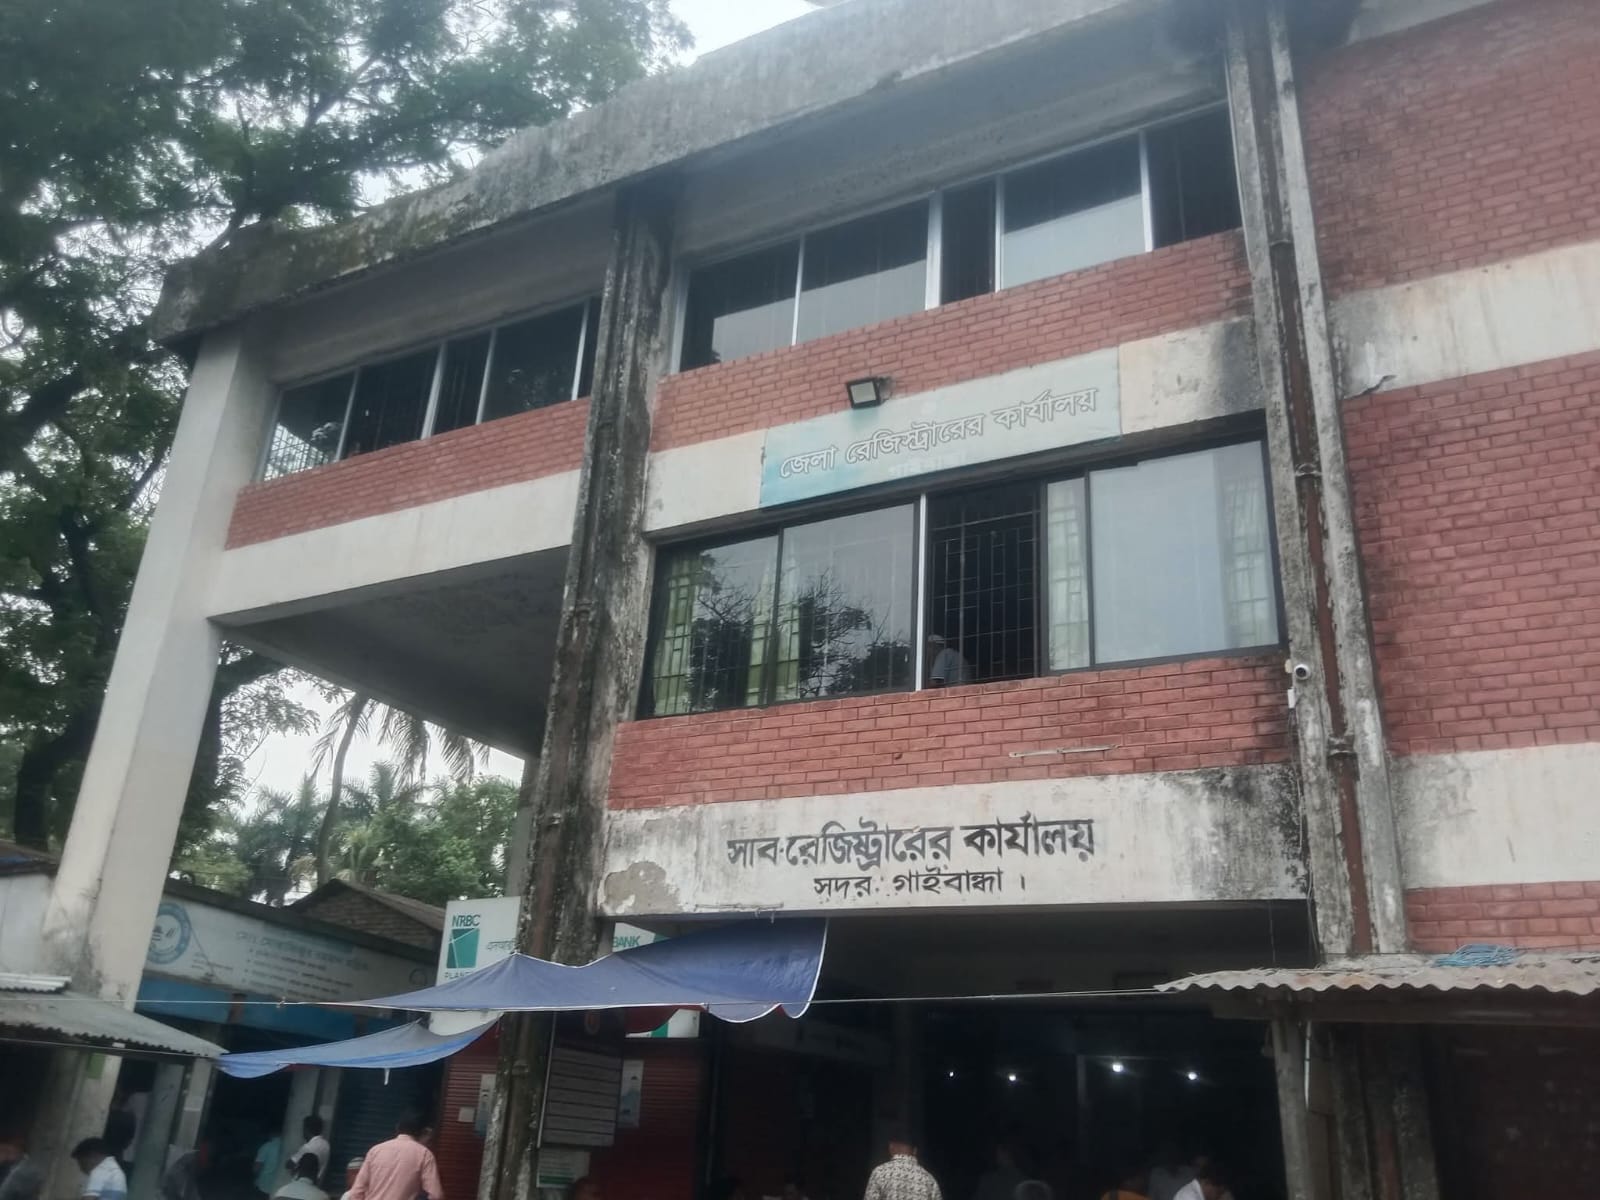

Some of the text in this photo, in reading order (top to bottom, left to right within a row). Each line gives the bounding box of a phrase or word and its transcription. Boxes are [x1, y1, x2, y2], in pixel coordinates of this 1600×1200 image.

[780, 444, 839, 478] জেলা
[845, 413, 985, 465] রেজিস্ট্রারের
[990, 388, 1099, 430] কার্যালয়
[960, 810, 1094, 862] কার্যালয়
[892, 865, 1003, 894] গাইবান্ধা
[452, 914, 481, 927] NRBC
[613, 935, 640, 948] BANK
